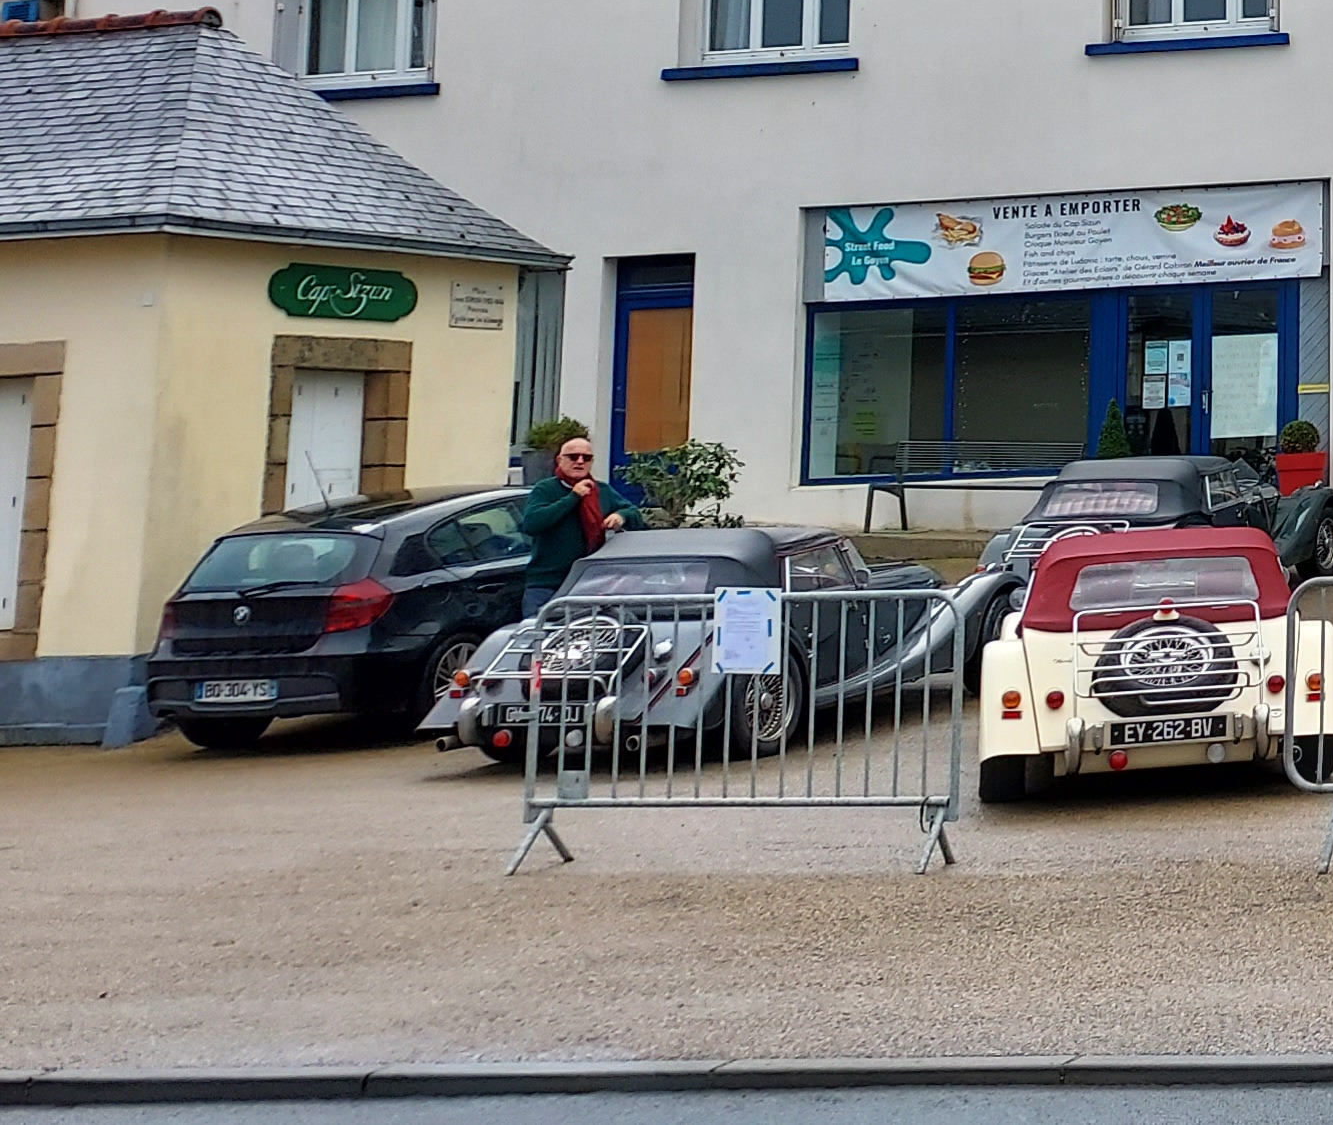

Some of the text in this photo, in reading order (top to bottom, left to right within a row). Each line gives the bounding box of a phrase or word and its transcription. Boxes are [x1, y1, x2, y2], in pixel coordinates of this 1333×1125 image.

[993, 198, 1141, 219] VENTE A EMPORTER
[1064, 220, 1080, 228] Cap
[1025, 232, 1052, 240] Burgers
[844, 240, 895, 252] Street Food
[1024, 240, 1052, 248] Croque
[1088, 237, 1112, 245] Goyen
[851, 256, 889, 266] Le Goyen
[1227, 258, 1255, 266] ouvrier
[1270, 256, 1296, 264] France
[297, 272, 393, 316] Cap Sizun
